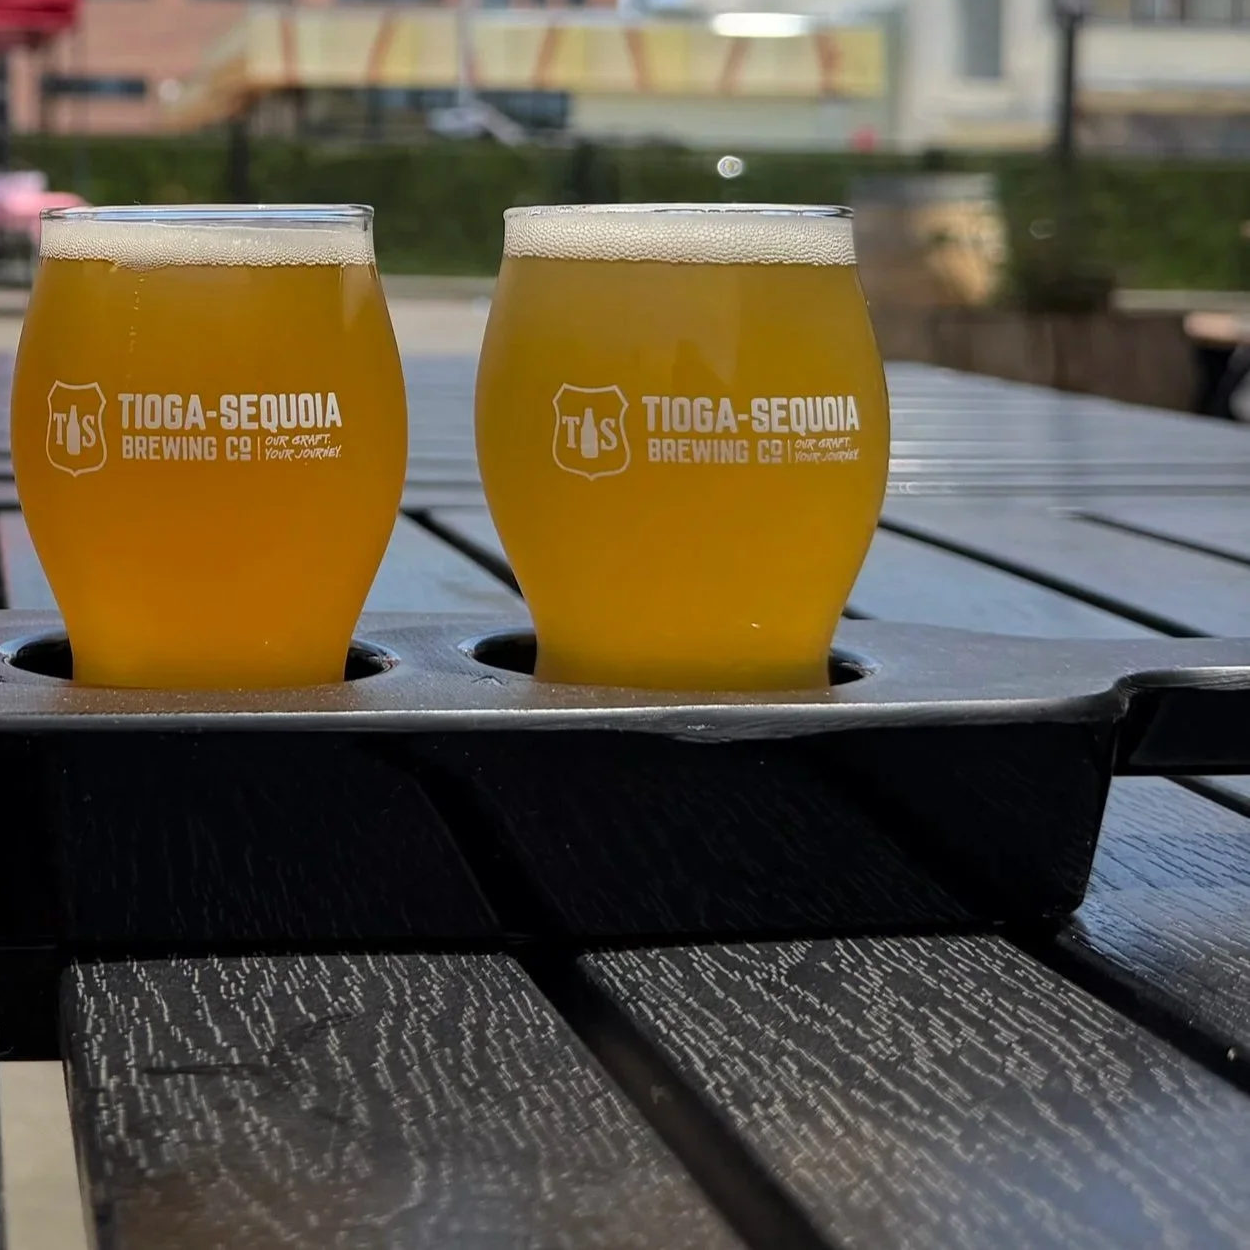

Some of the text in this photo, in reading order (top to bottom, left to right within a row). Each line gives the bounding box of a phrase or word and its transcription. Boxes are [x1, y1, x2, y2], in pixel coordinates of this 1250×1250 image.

[118, 392, 342, 433] TIOGA-SEQUOIA
[642, 396, 860, 436] TIOGA-SEQUOIA
[122, 436, 217, 460] BREWING
[265, 436, 289, 448] OUR
[265, 448, 294, 461] YOUR
[647, 438, 749, 464] BREWING
